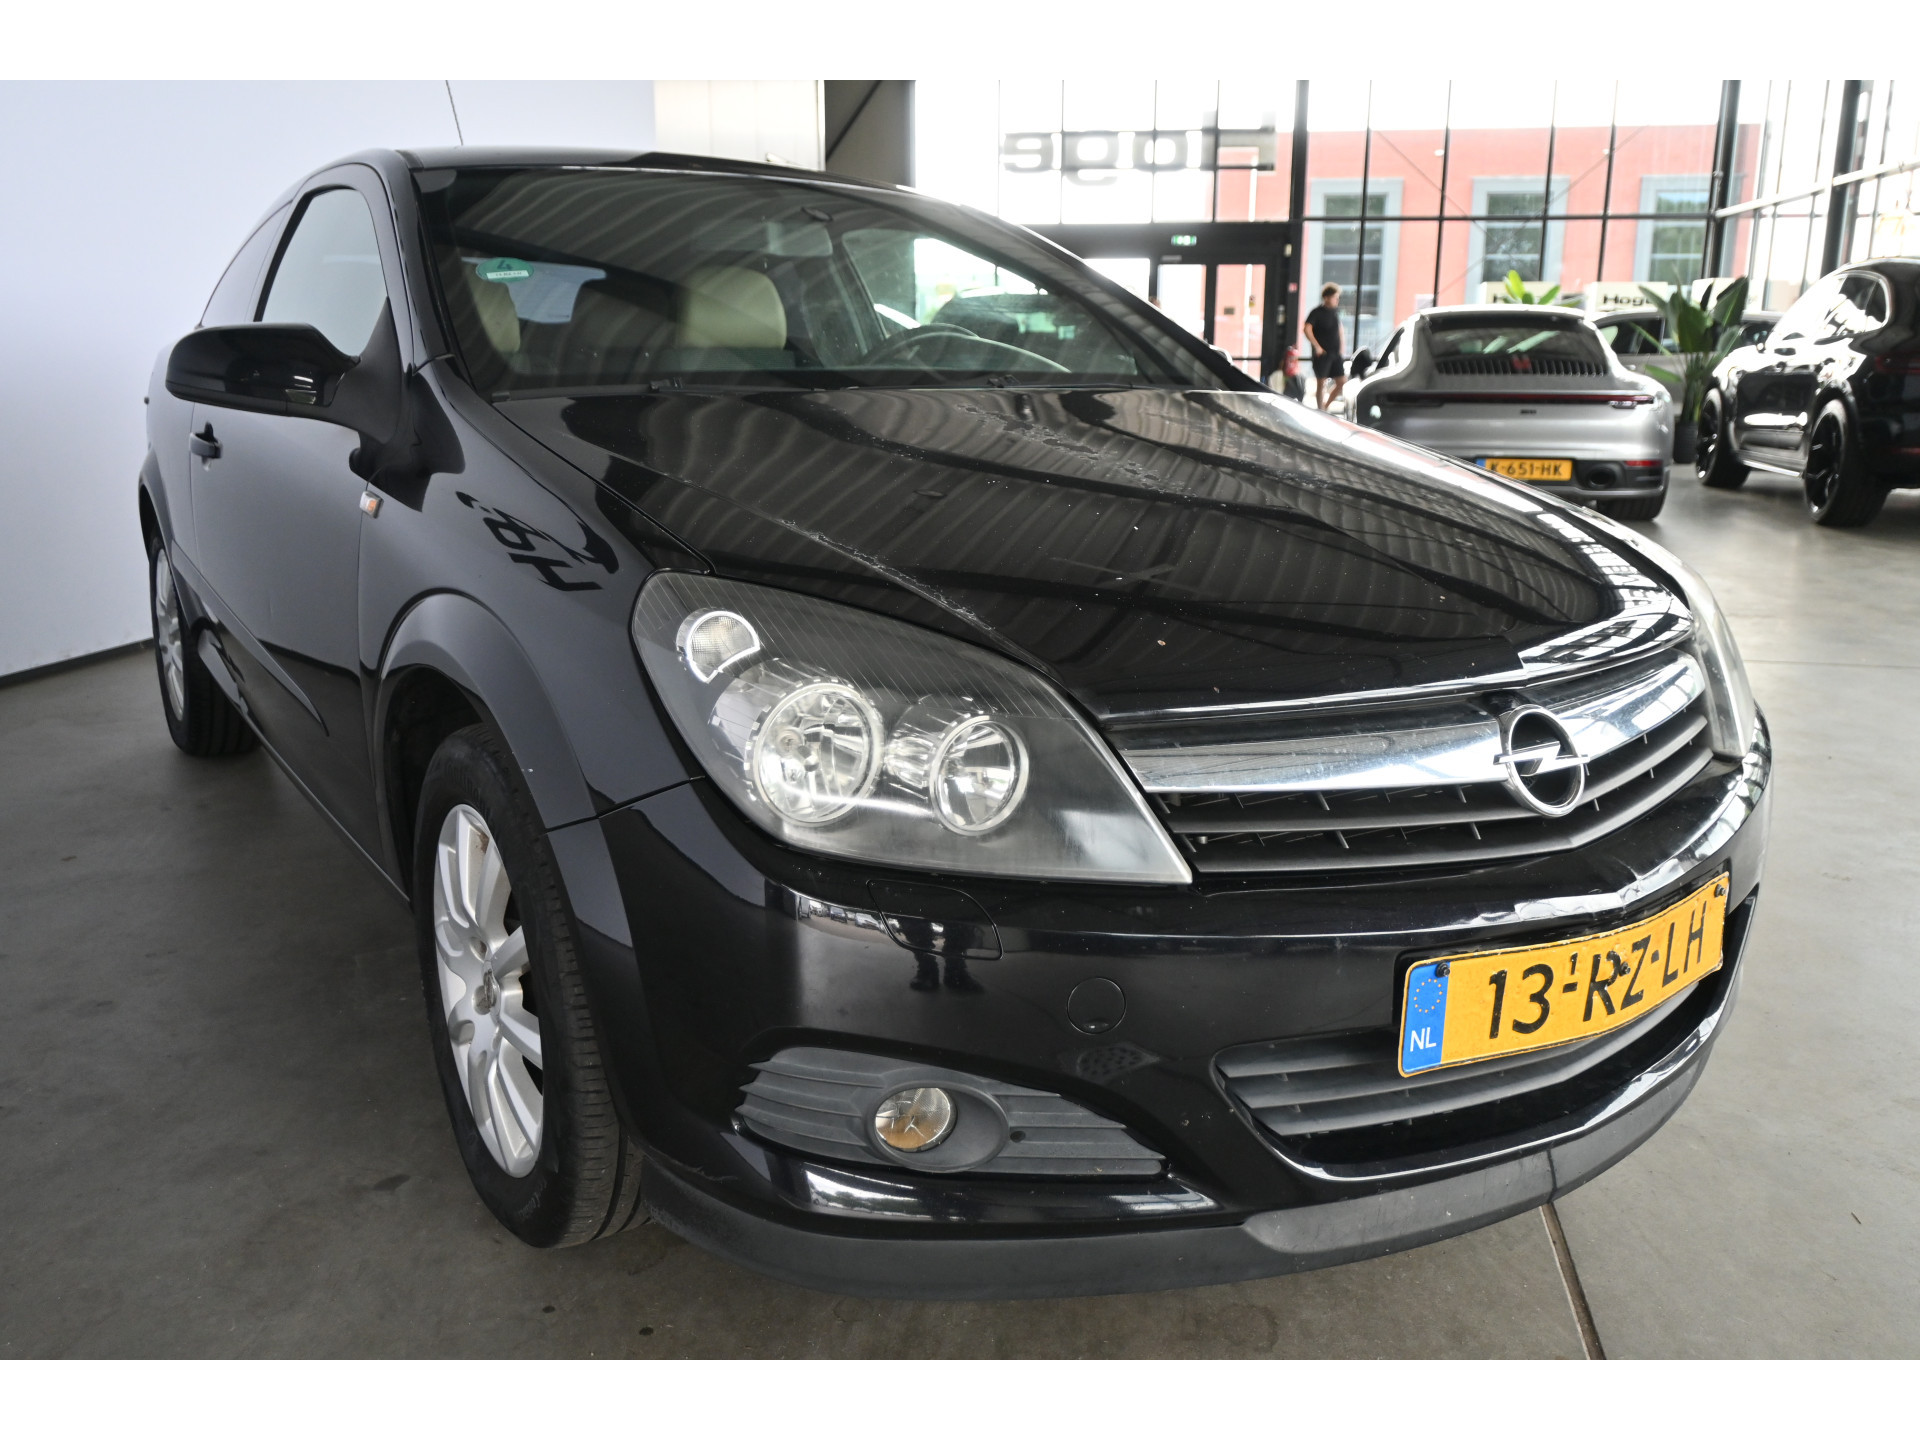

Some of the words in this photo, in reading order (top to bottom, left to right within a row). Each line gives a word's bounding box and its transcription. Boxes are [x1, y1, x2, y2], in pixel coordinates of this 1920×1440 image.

[1490, 462, 1562, 476] K-651-HK
[1488, 901, 1708, 1040] 13-RZ-LH
[1410, 1026, 1437, 1052] NL
